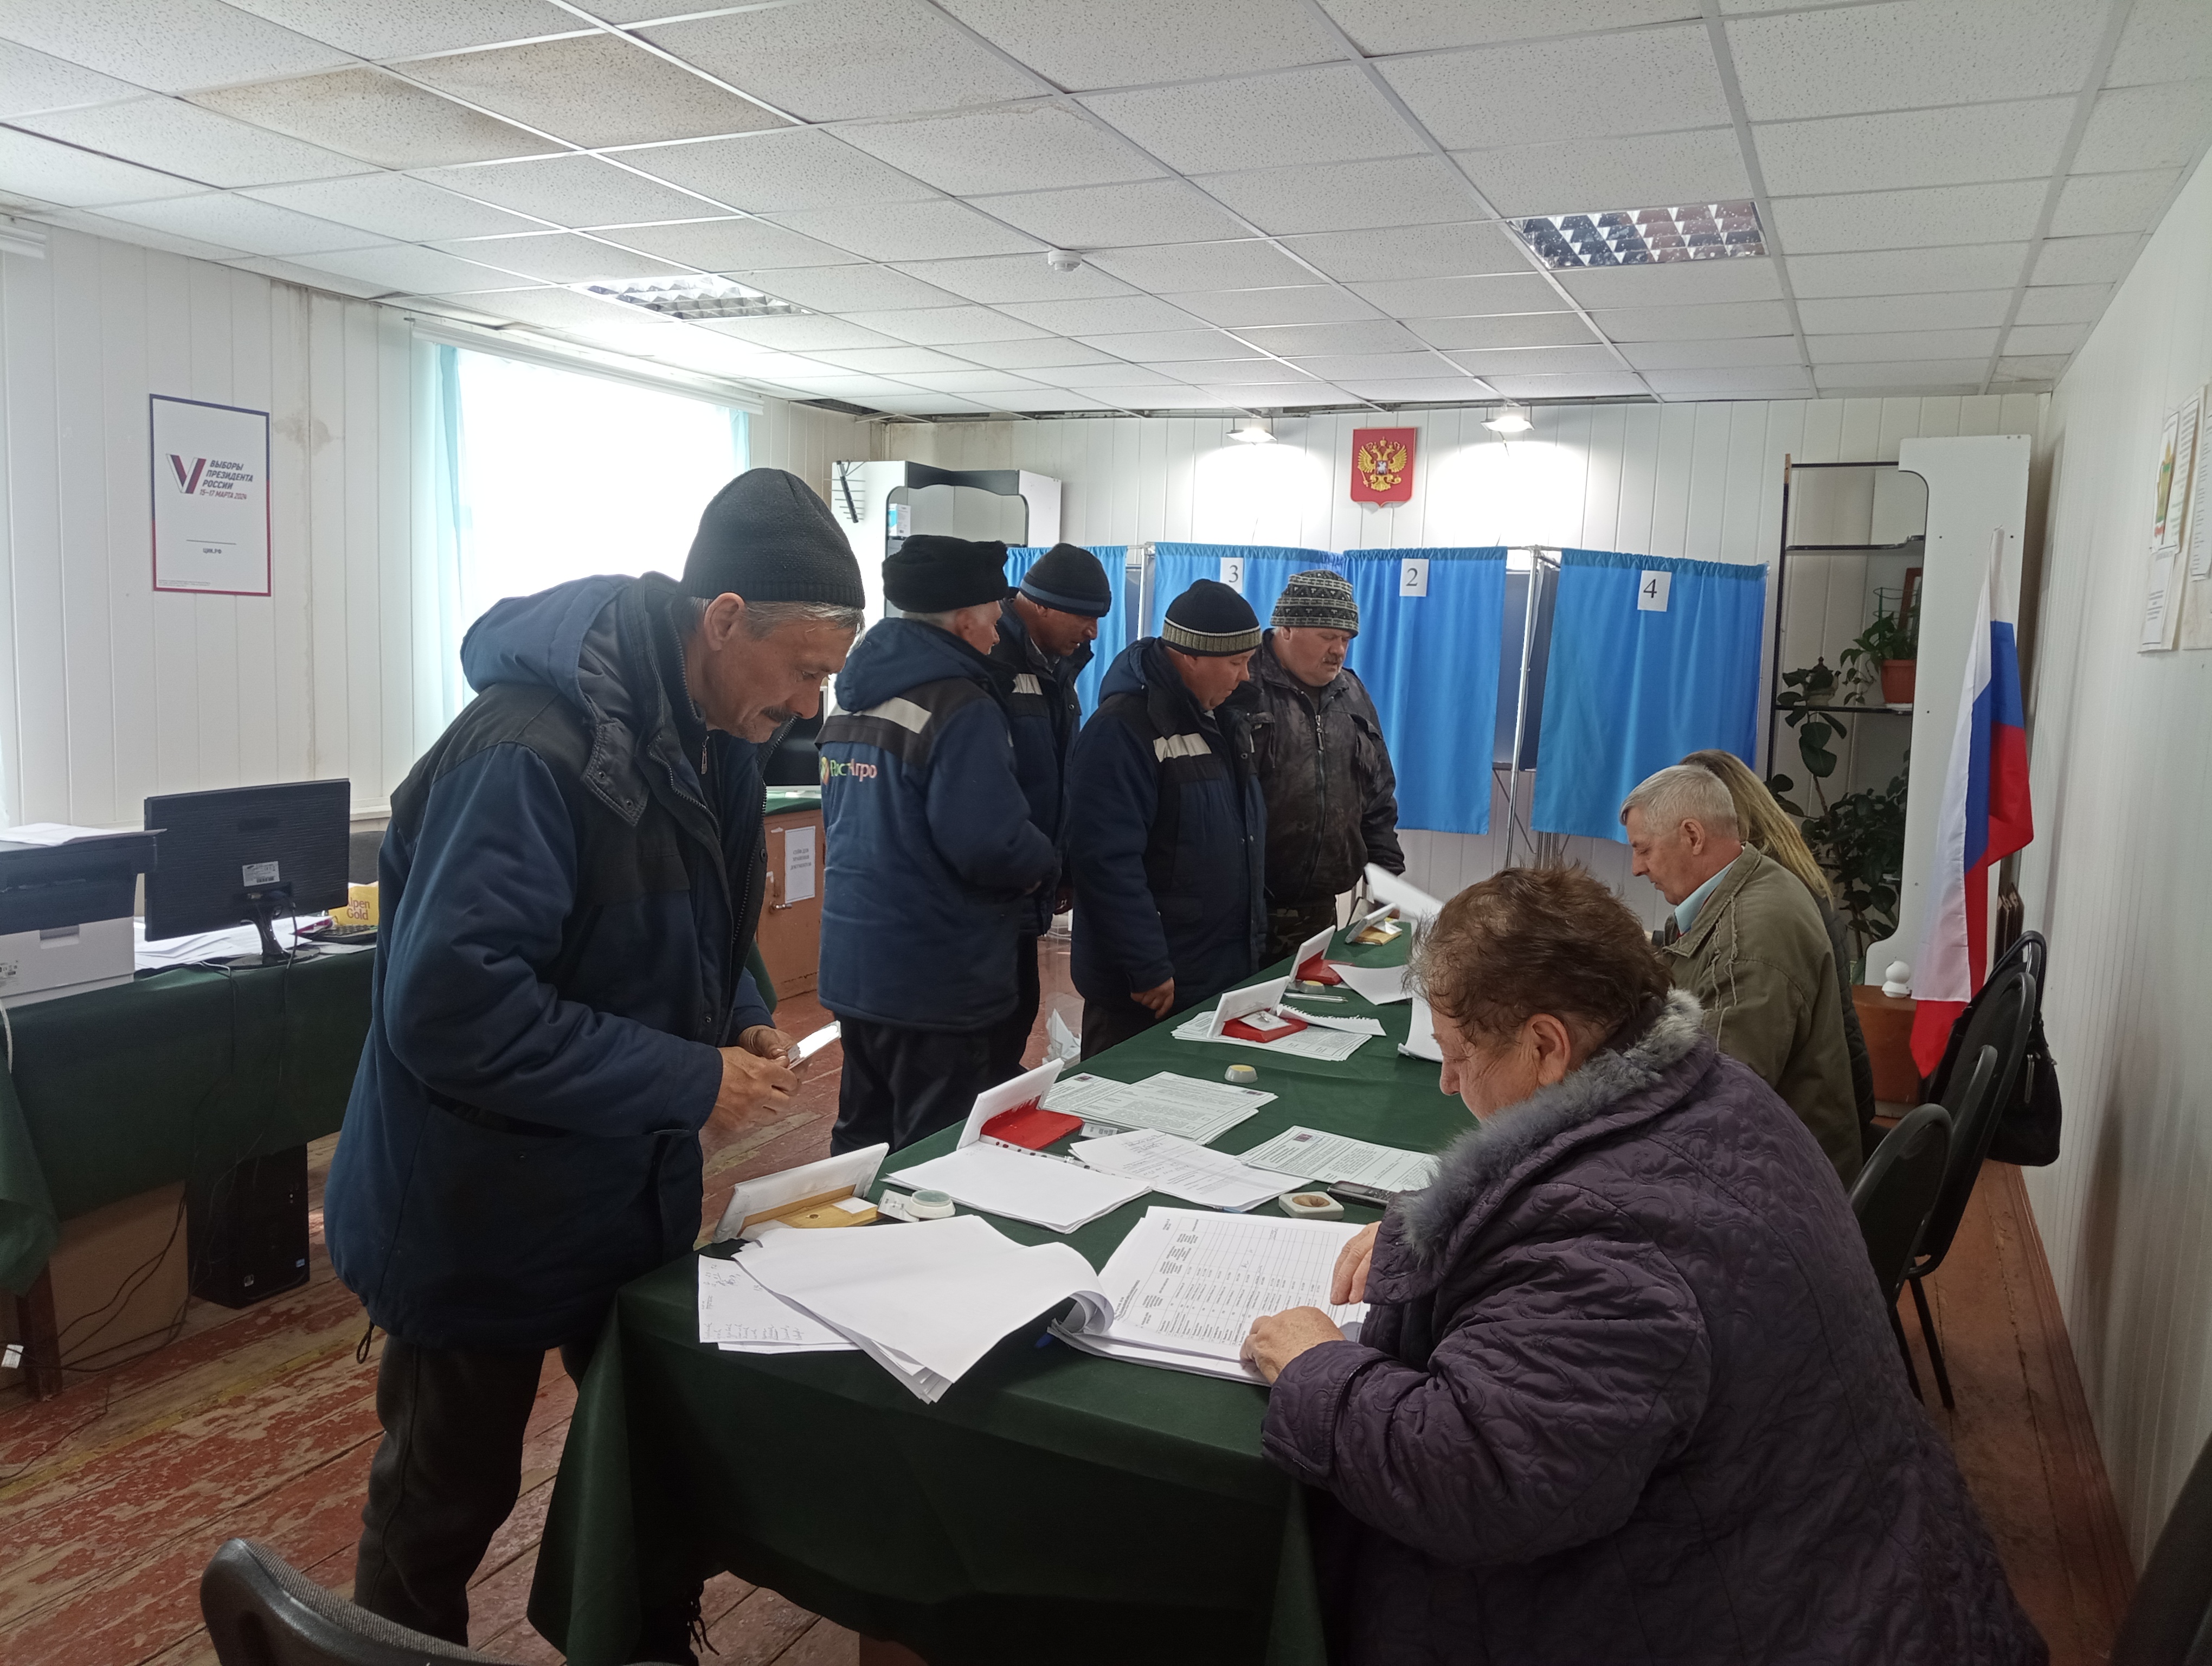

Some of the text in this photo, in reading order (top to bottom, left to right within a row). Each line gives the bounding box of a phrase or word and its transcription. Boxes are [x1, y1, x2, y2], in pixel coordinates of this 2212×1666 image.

[210, 460, 244, 471] ВЫБОРЫ
[205, 470, 253, 482] ПРЕЗИДЕНТА
[202, 479, 234, 490] РОССИИ
[215, 490, 234, 498] МАРТА
[1229, 565, 1239, 583] 3
[1406, 567, 1418, 586] 2
[1643, 578, 1657, 598] 4
[349, 896, 370, 911] lpen
[346, 908, 369, 920] Gold
